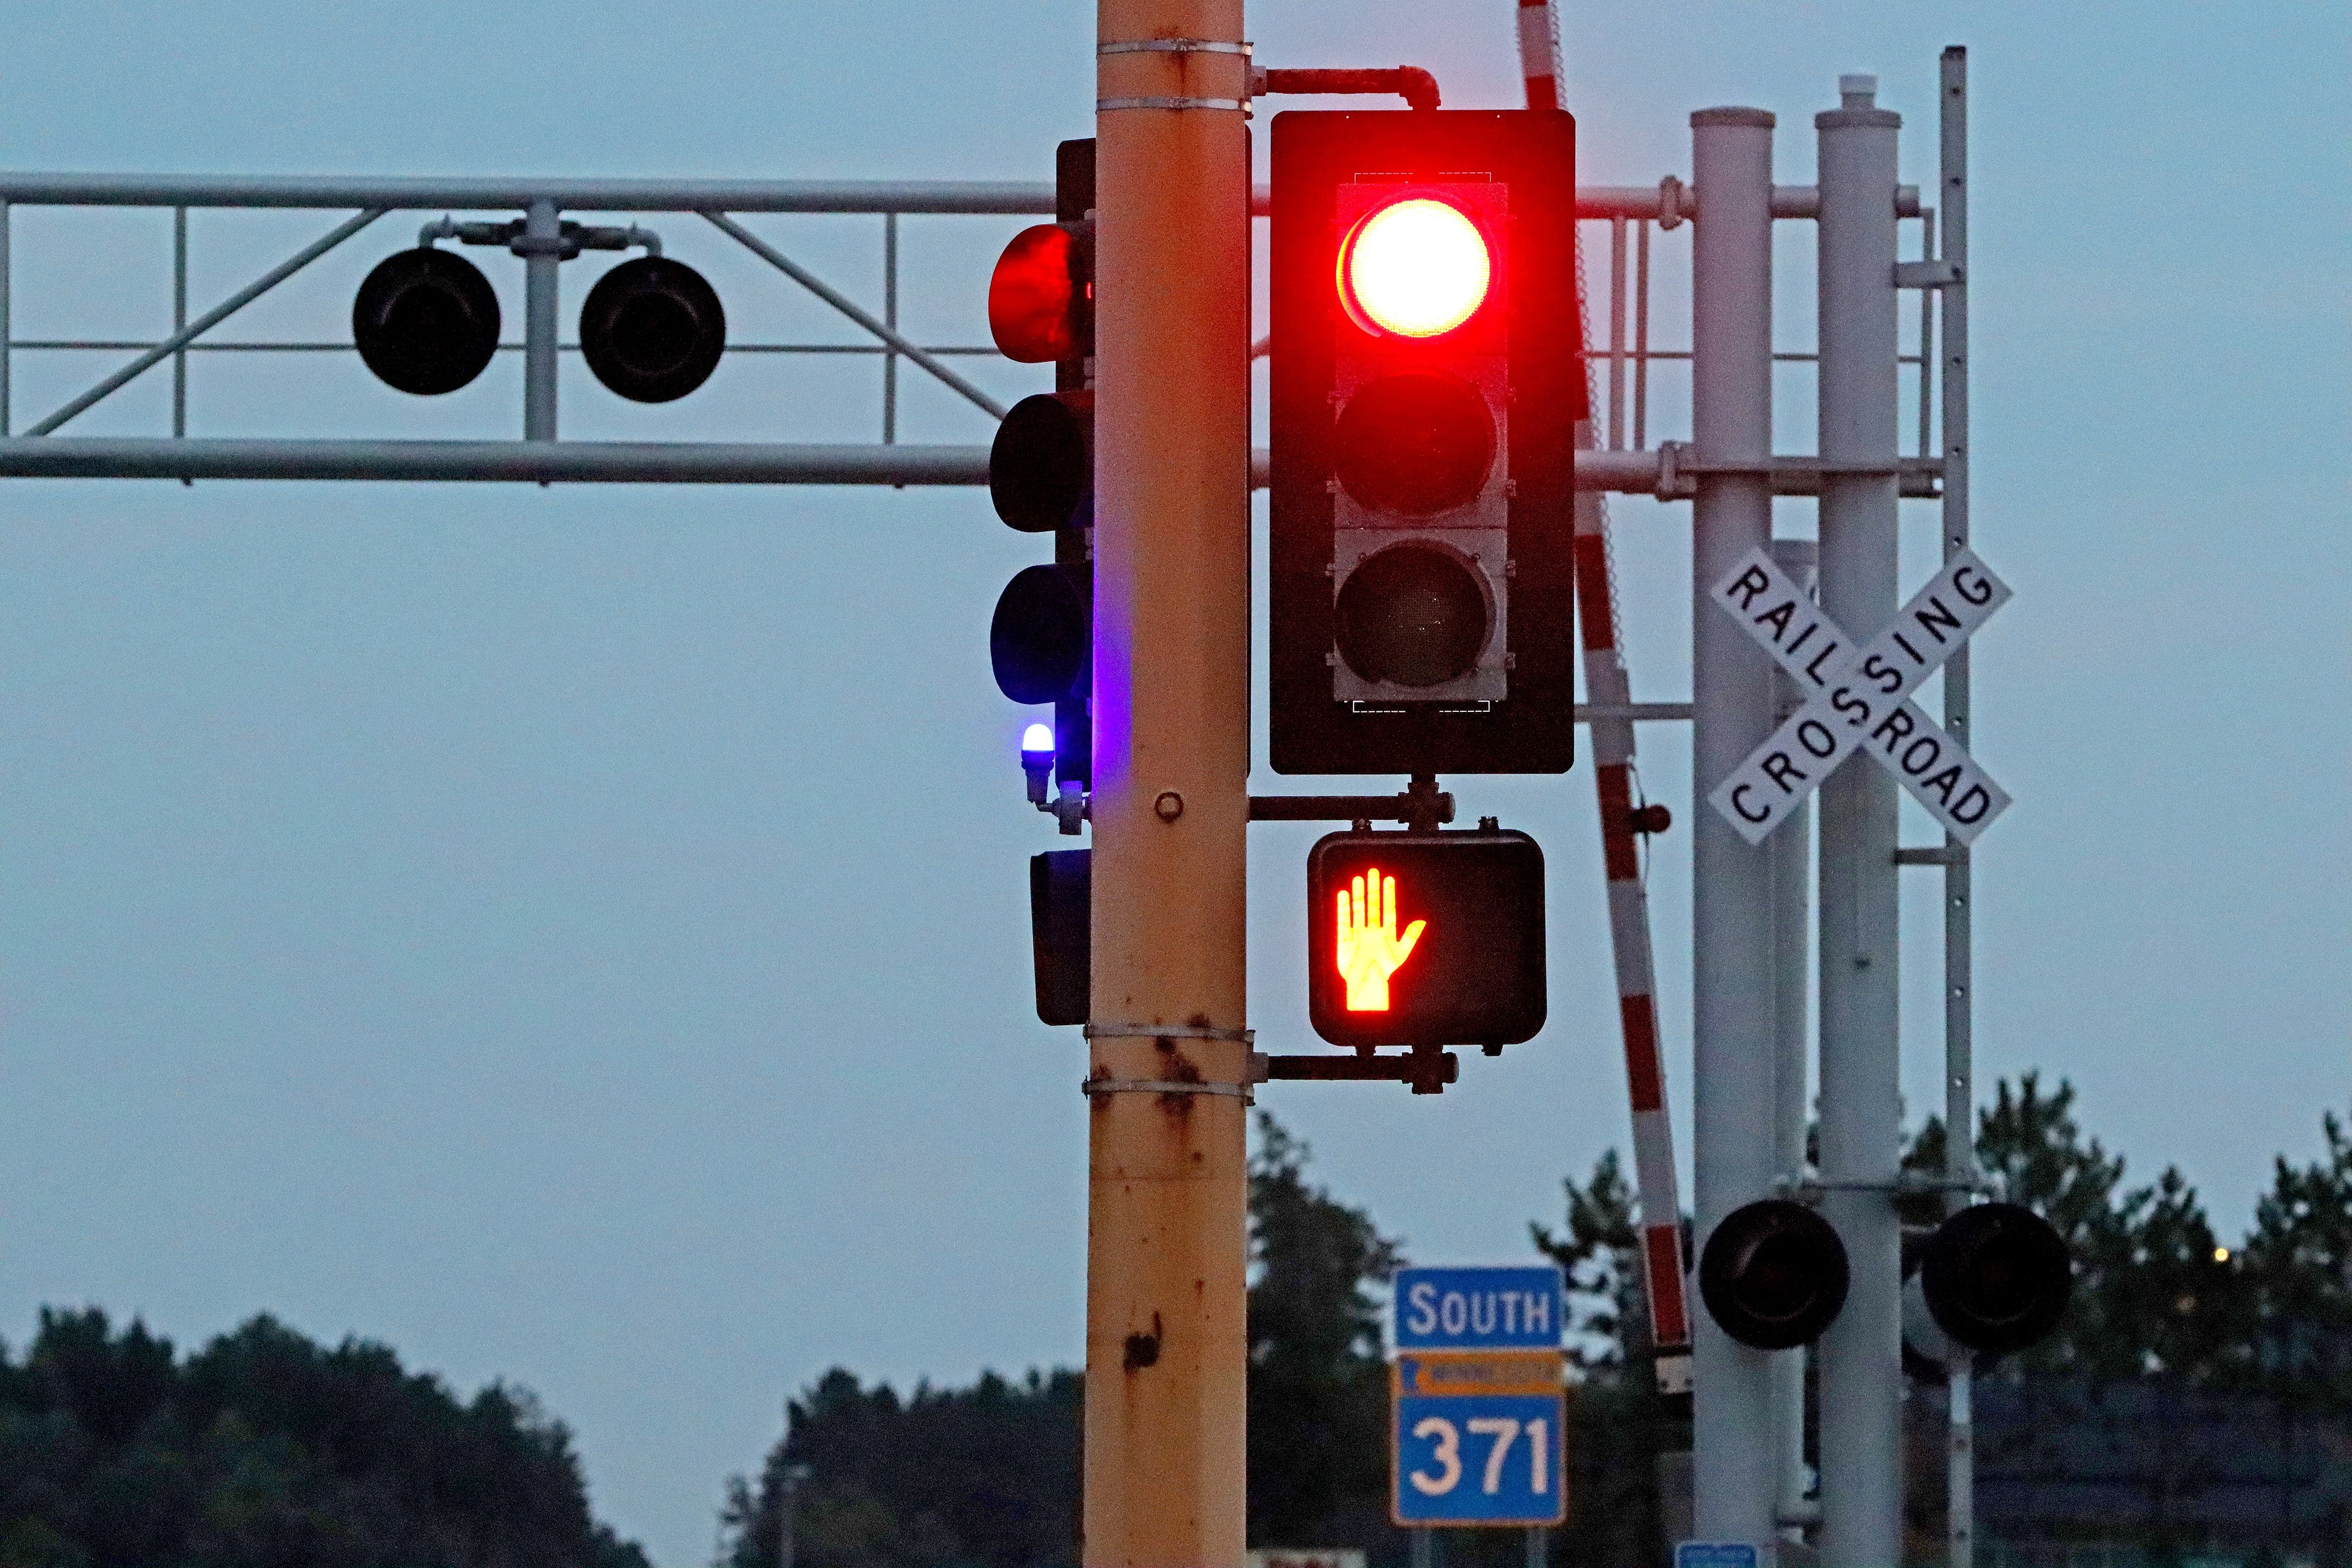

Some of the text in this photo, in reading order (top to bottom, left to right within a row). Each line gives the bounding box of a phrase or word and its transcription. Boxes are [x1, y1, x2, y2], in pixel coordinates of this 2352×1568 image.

[1731, 566, 1992, 823] CROSSING
[1408, 1283, 1550, 1334] SOUTH
[1410, 1417, 1549, 1495] 371
